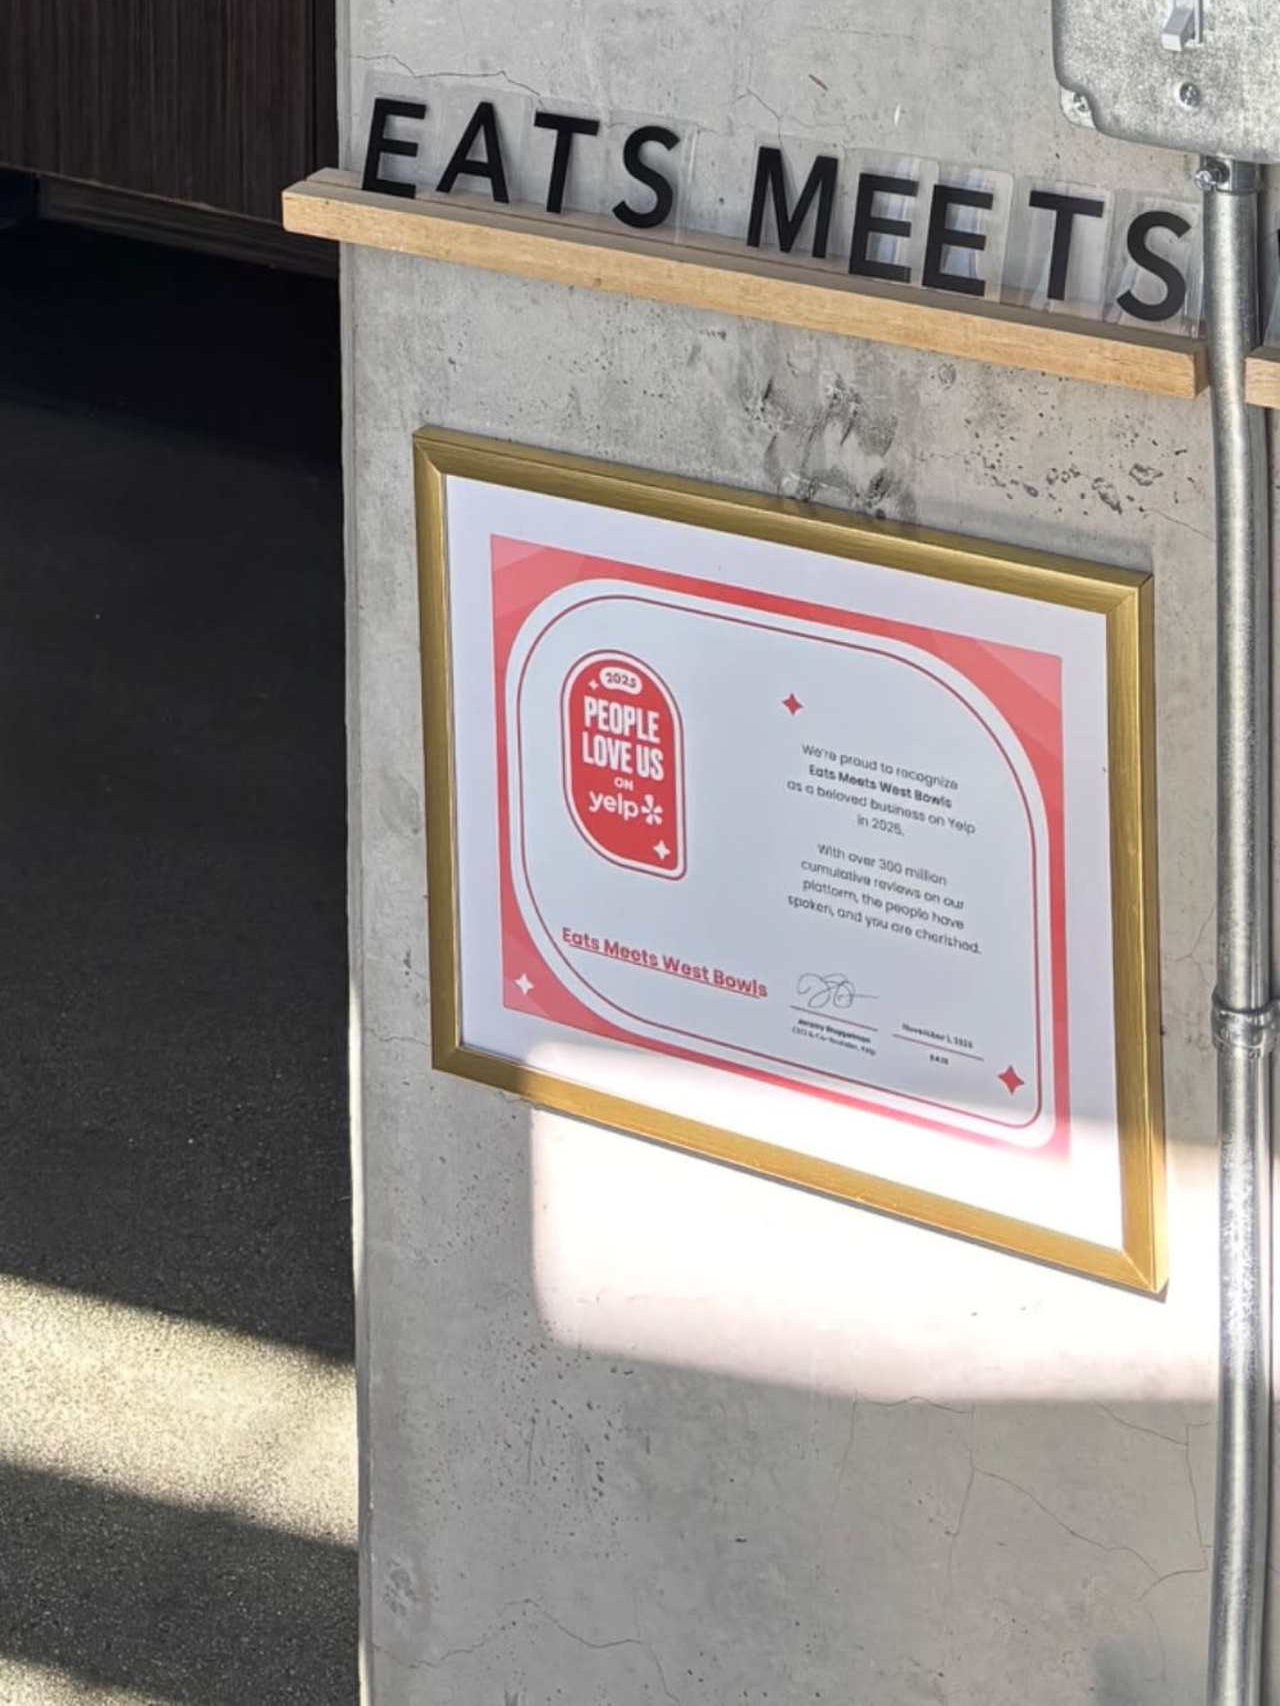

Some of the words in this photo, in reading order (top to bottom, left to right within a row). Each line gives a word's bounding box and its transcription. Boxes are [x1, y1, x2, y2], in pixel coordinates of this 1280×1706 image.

[361, 96, 681, 230] EATS
[744, 145, 1192, 324] MEETS
[605, 672, 637, 689] 2025
[583, 695, 660, 744] PEOPLE
[581, 730, 633, 774] LOVE
[635, 744, 665, 782] US
[840, 753, 877, 772] proud
[880, 762, 894, 776] to
[896, 767, 959, 791] recognize
[587, 790, 639, 821] yelp
[613, 776, 634, 791] ON
[808, 763, 836, 781] Eats
[838, 771, 877, 791] Meets
[879, 781, 912, 800] West
[914, 789, 952, 809] Bowls
[786, 779, 803, 793] as
[816, 786, 867, 807] beloved
[870, 798, 926, 822] business
[928, 813, 945, 827] on
[947, 817, 977, 836] Yelp
[857, 814, 869, 827] in
[800, 859, 871, 886] cumulative
[873, 878, 921, 900] reviews
[923, 889, 941, 903] on
[942, 896, 964, 910] our
[817, 843, 846, 861] With
[848, 851, 876, 868] over
[878, 858, 903, 875] 300
[905, 866, 948, 887] million
[836, 905, 863, 923] and
[864, 913, 889, 931] you
[890, 921, 912, 937] are
[861, 891, 883, 908] the
[884, 899, 929, 922] people
[931, 911, 965, 931] have
[562, 926, 600, 951] Eats
[603, 938, 659, 967] Meets
[662, 954, 709, 980] West
[713, 968, 768, 998] Bowls
